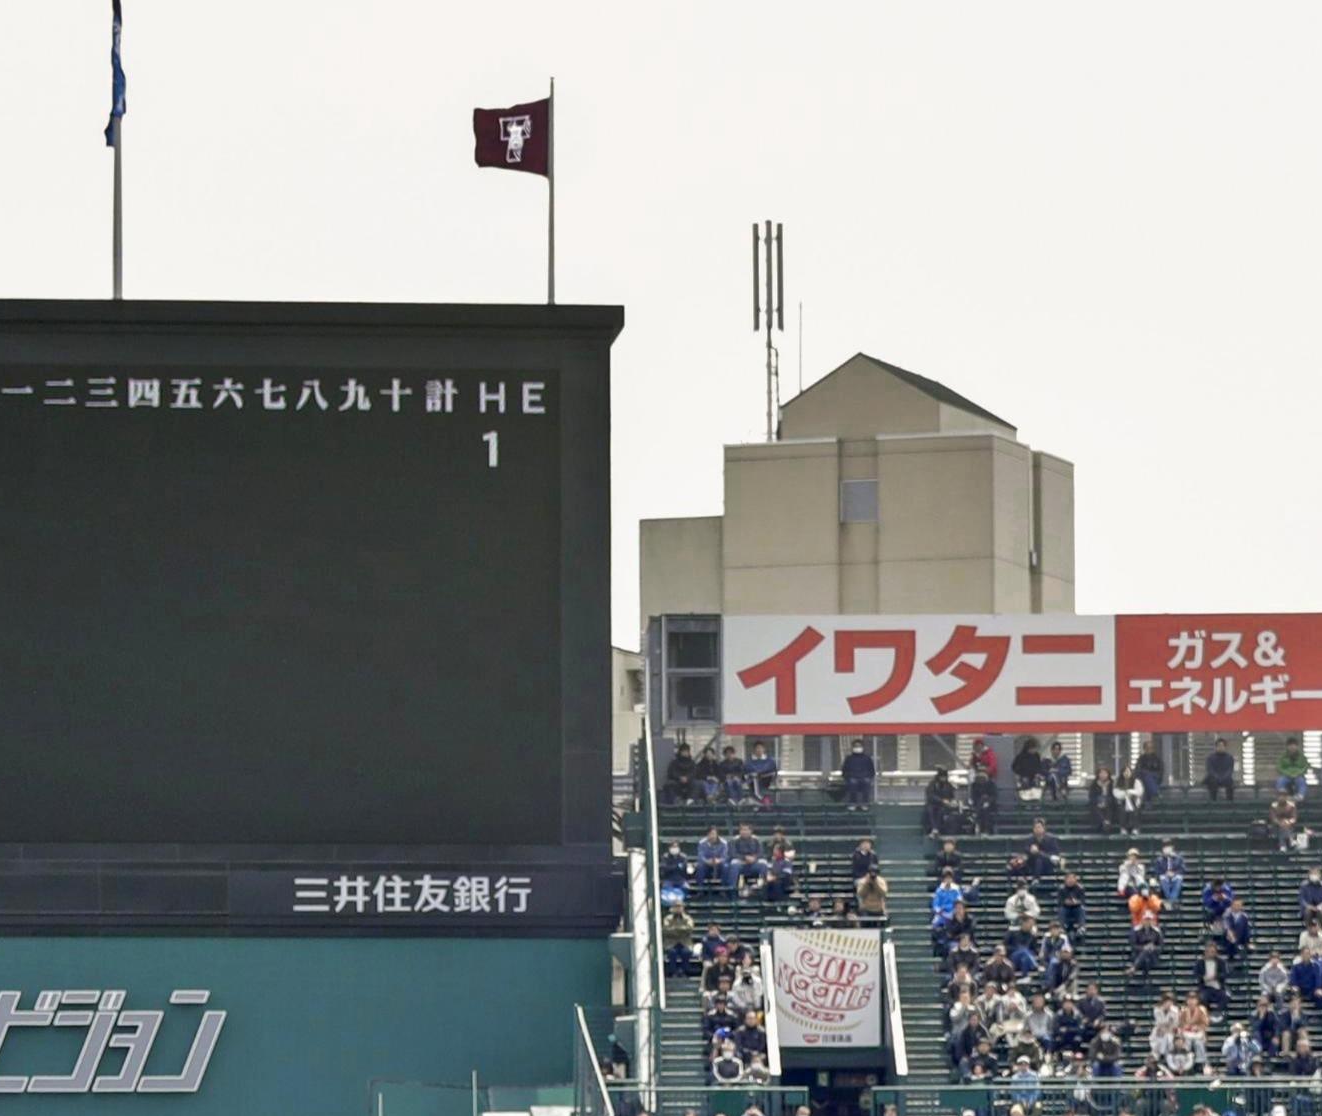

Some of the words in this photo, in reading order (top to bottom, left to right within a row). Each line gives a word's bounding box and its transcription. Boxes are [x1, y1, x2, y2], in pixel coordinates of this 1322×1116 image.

[481, 430, 500, 468] 1
[1167, 630, 1285, 670] ガス&
[736, 625, 1102, 716] イワタニ
[292, 873, 533, 913] 三井住友銀行
